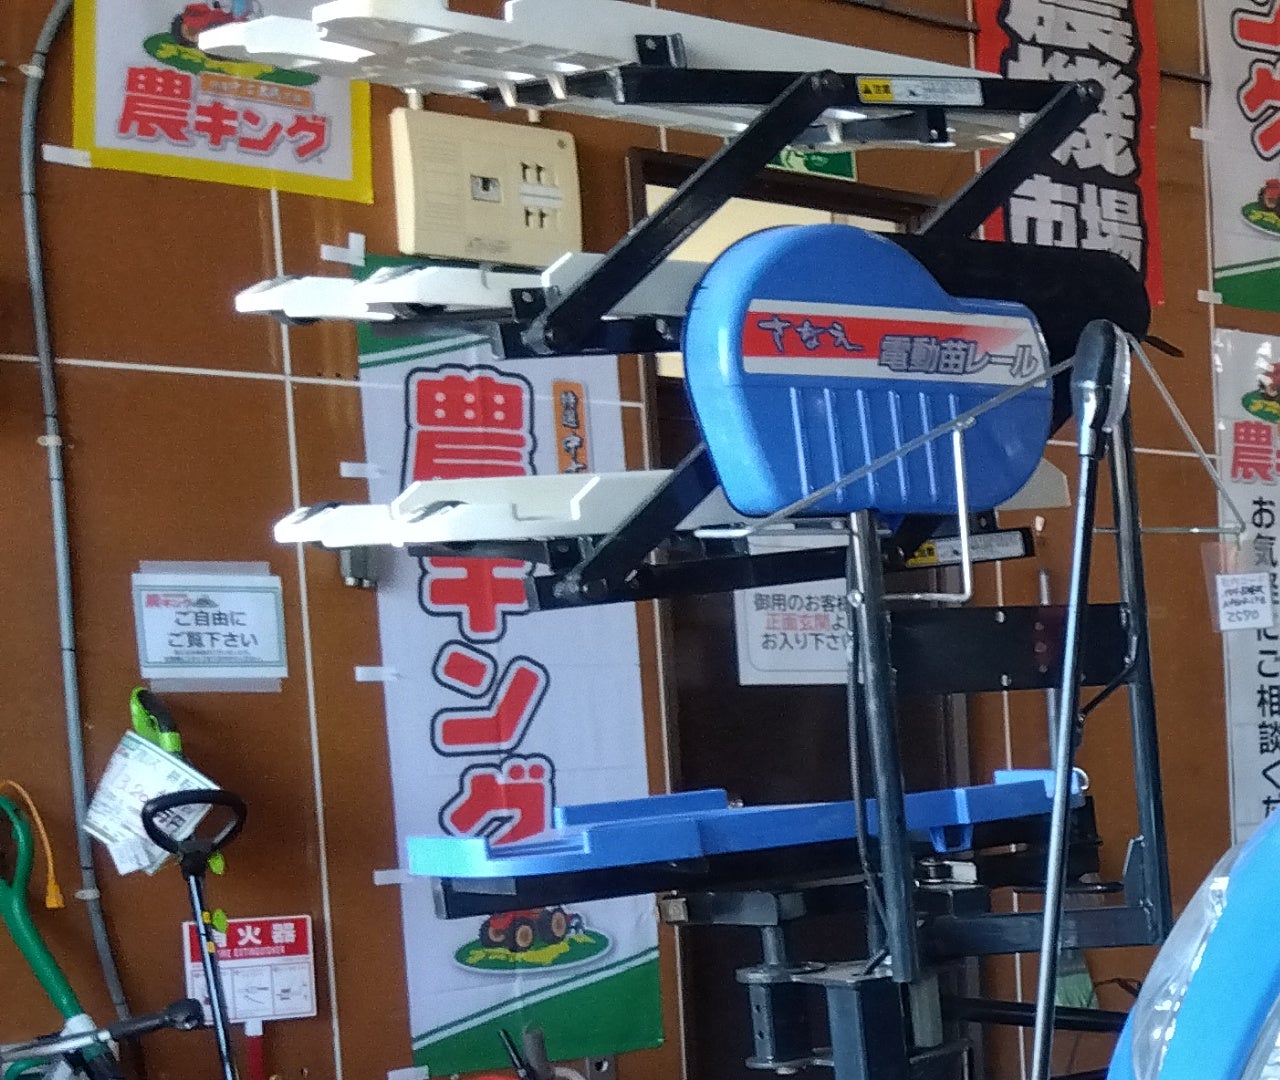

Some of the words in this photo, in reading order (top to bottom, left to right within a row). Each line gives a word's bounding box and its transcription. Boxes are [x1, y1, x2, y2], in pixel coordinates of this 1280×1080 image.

[117, 66, 330, 160] 農キング
[757, 314, 864, 354] さなえ
[877, 333, 1039, 379] 電動苗レール
[174, 609, 248, 627] ご自由に
